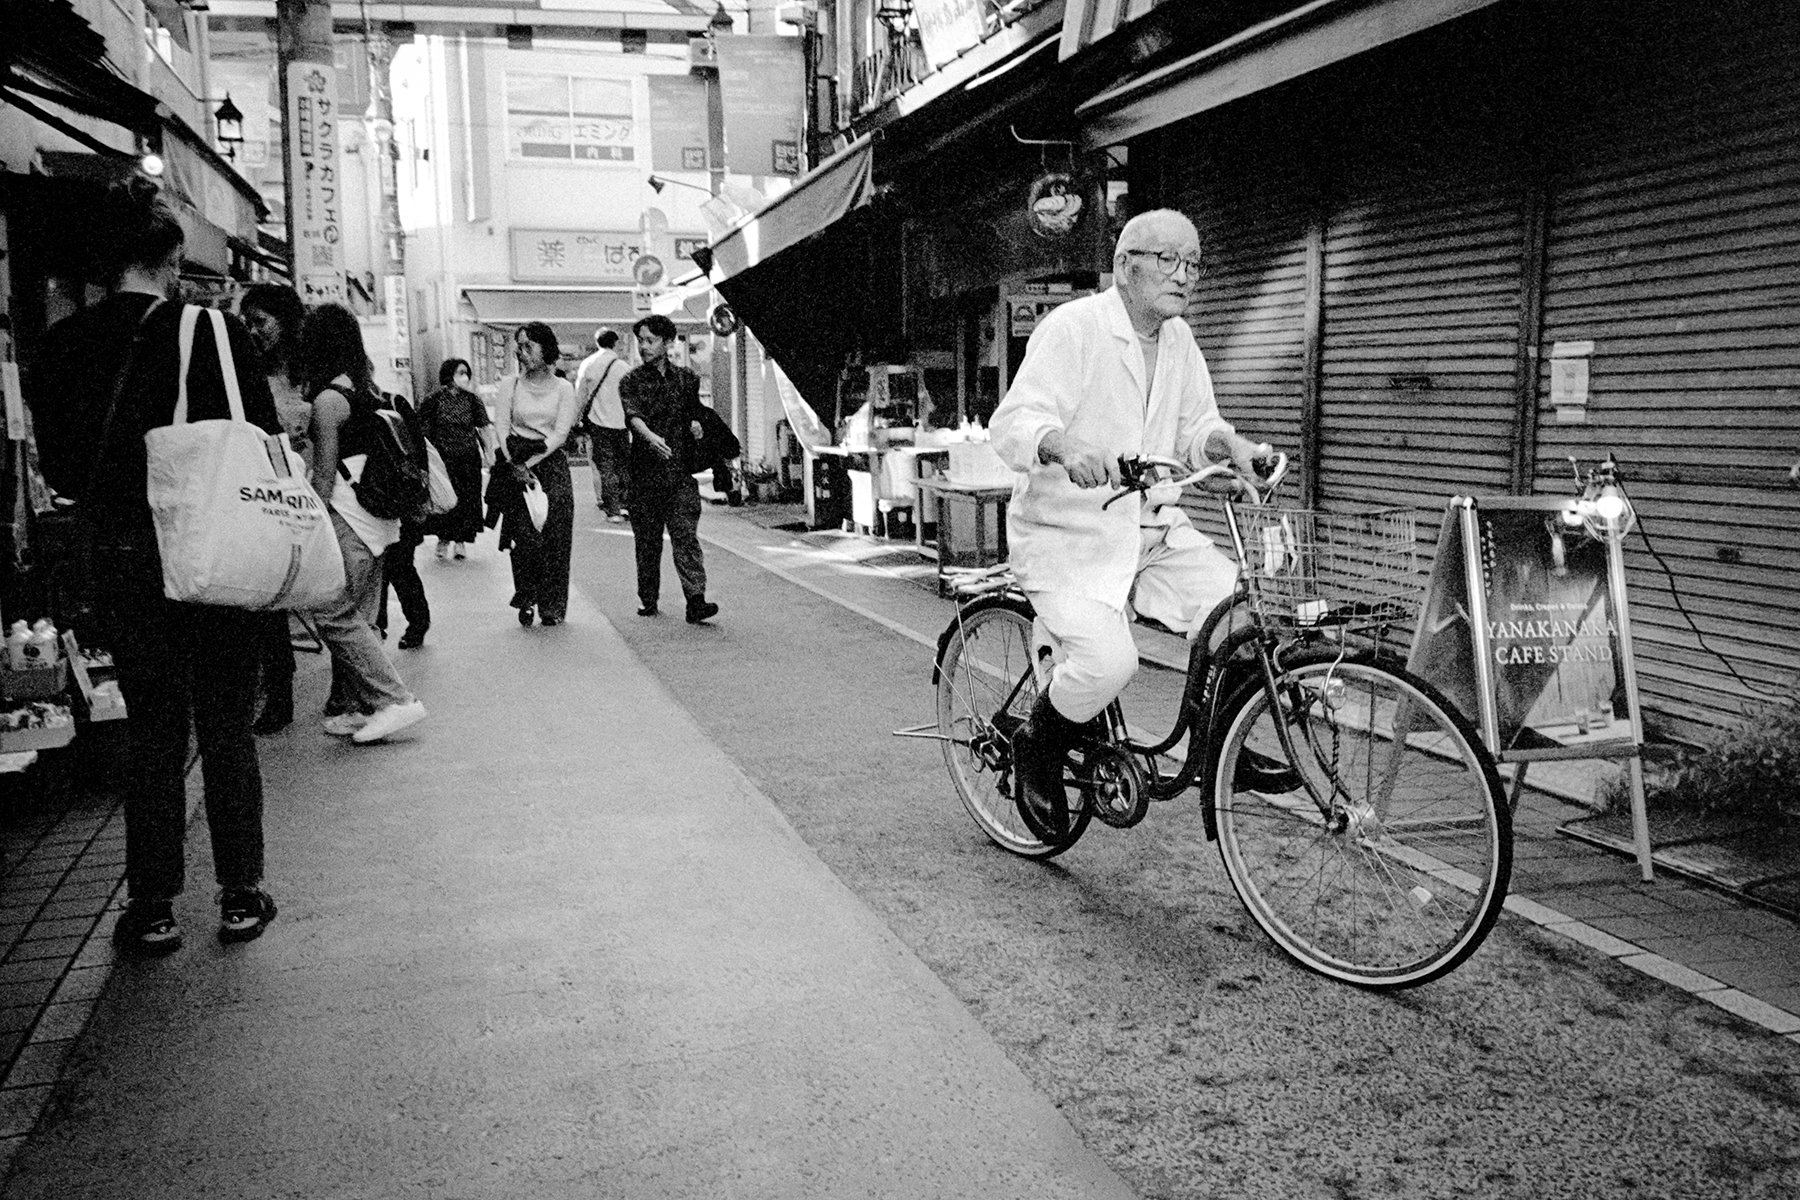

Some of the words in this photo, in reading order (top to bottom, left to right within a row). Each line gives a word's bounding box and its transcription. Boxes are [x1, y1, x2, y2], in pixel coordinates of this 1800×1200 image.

[1487, 619, 1619, 639] YANAKANAKA
[1495, 646, 1546, 665] CAFE
[1550, 645, 1613, 663] STAND
